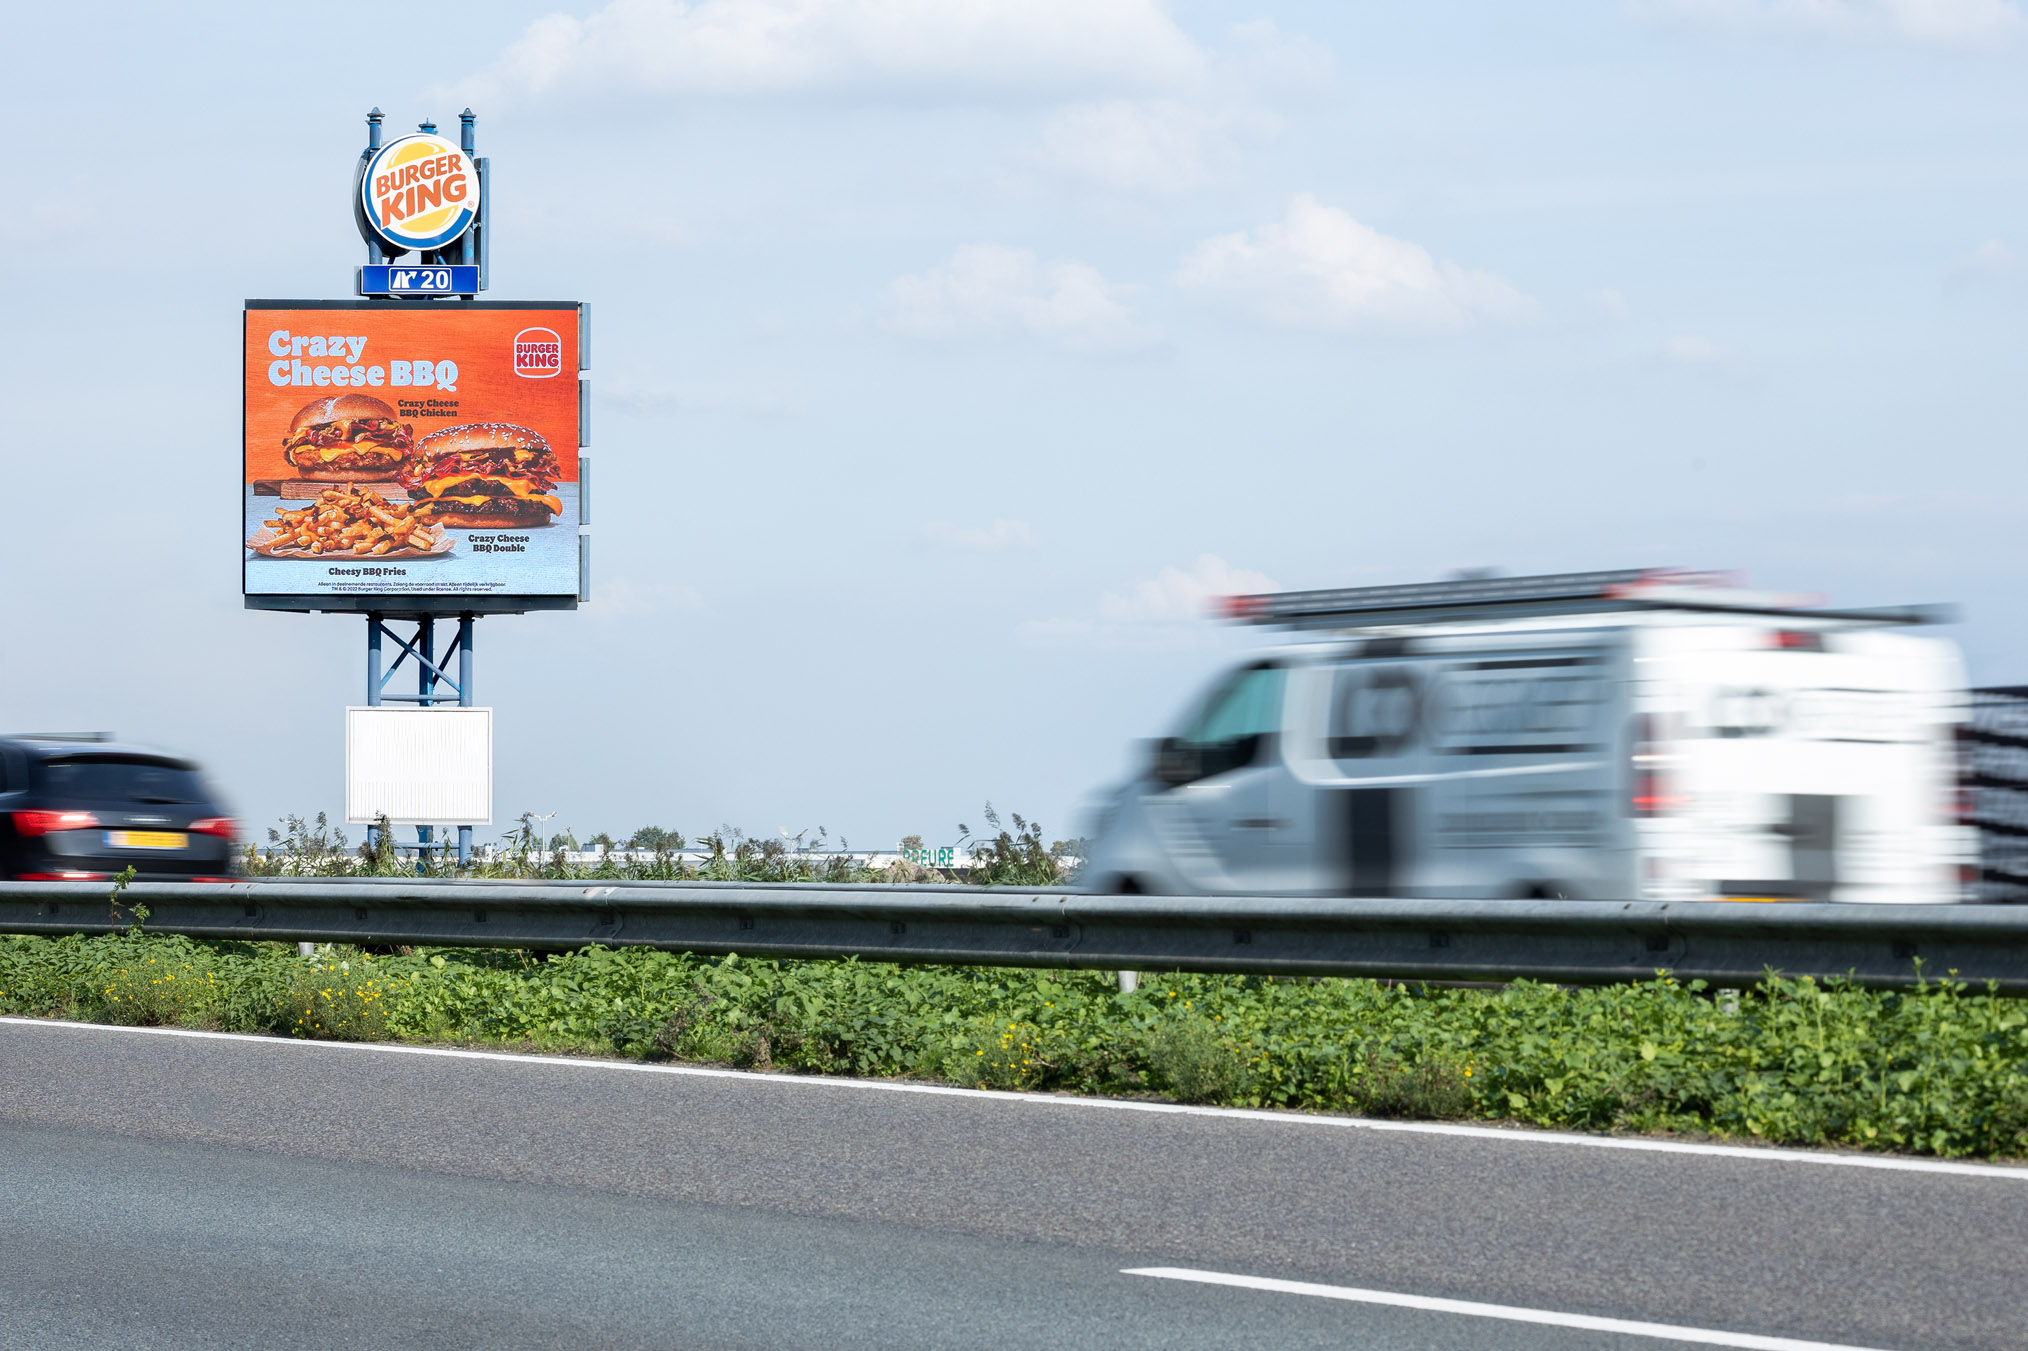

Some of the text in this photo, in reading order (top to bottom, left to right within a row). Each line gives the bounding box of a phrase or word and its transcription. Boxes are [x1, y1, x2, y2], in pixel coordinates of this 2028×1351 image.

[376, 154, 463, 199] BURGER
[381, 173, 467, 228] KING
[420, 270, 449, 289] 20
[268, 330, 368, 364] Crazy
[516, 343, 559, 353] BURGER
[516, 353, 559, 367] KING
[268, 358, 459, 392] Cheese BBQ
[398, 399, 459, 409] Crazy Cheese
[400, 409, 457, 418] BBQ Chicken
[468, 534, 530, 544] Crazy Cheese
[473, 544, 525, 553] BBQ Double
[328, 566, 406, 577] Cheesy BBQ Fries
